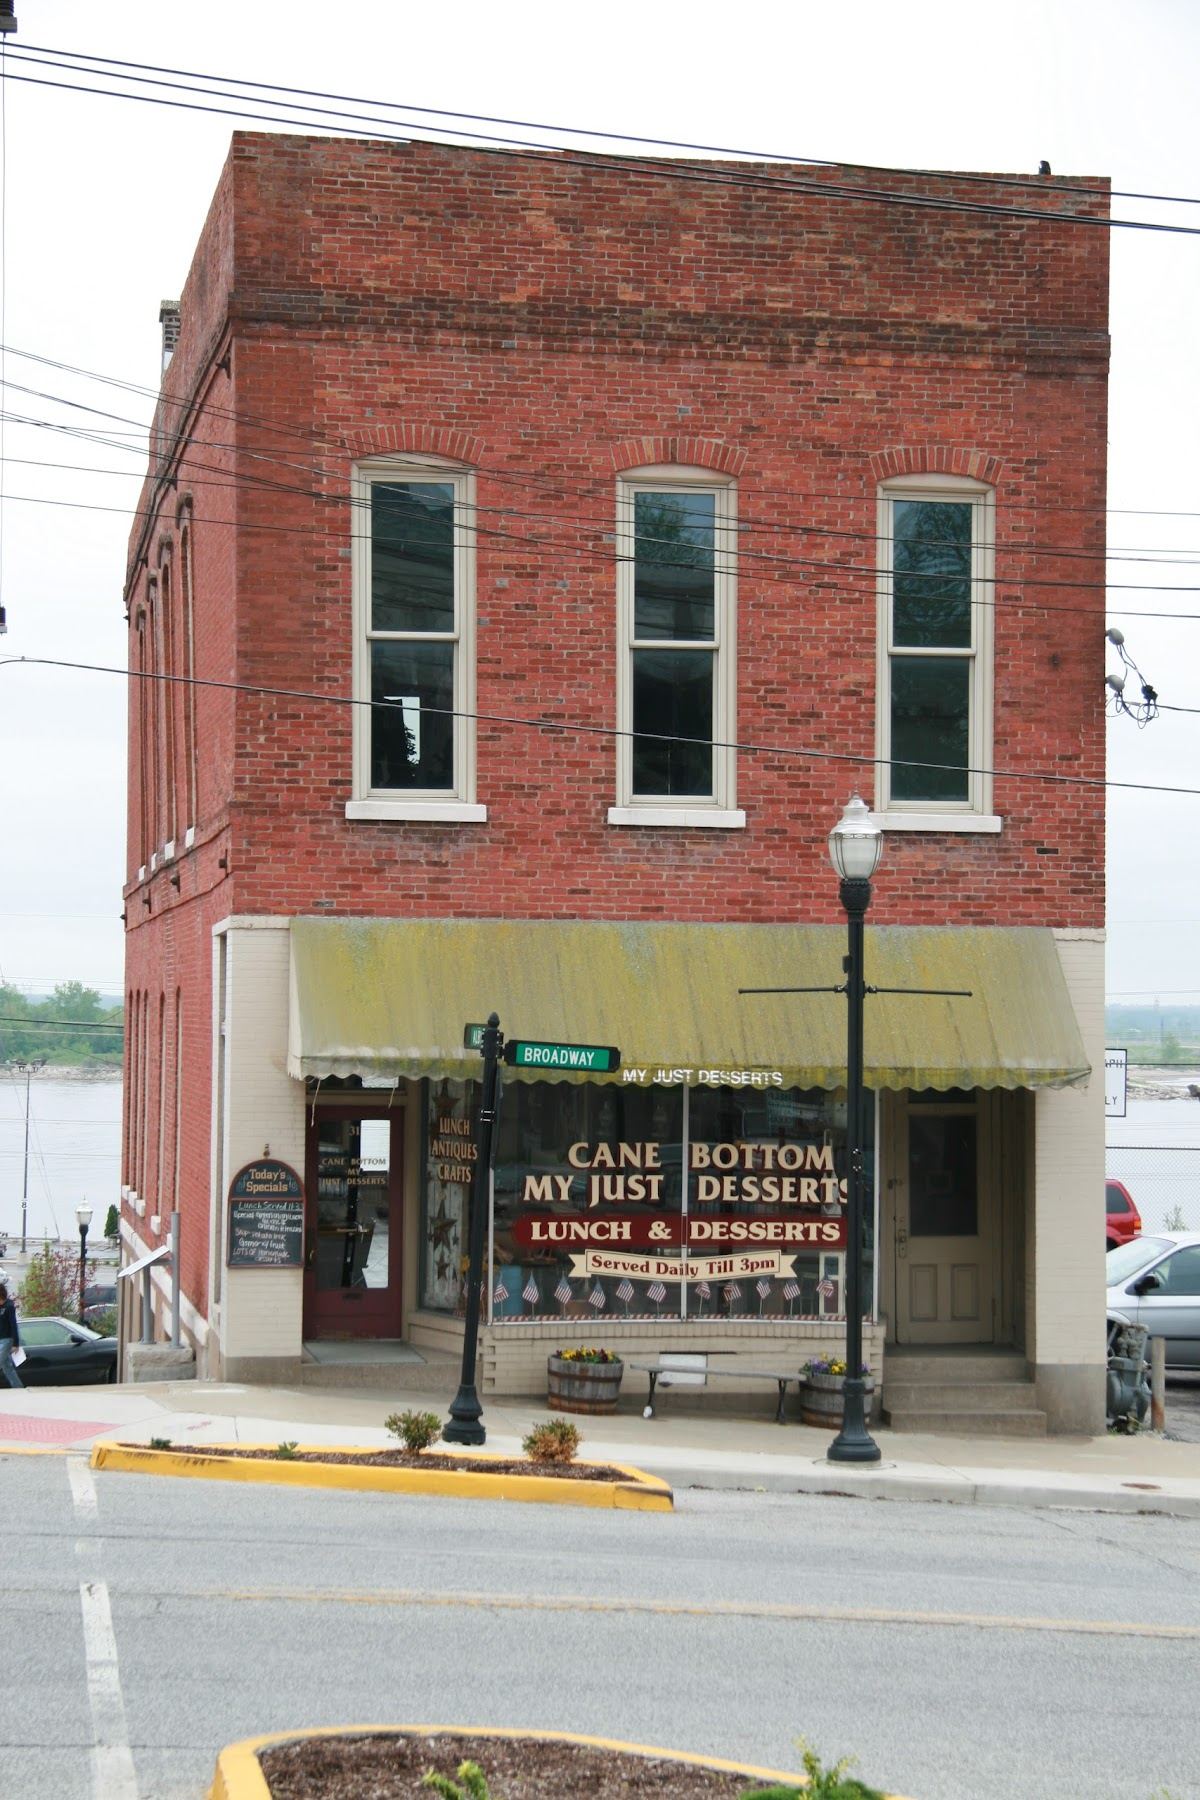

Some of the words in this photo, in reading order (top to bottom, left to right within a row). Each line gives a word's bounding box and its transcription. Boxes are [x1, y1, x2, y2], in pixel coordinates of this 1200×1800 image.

[524, 1047, 595, 1066] BROADWAY
[623, 1069, 647, 1082] MY
[653, 1069, 693, 1083] JUST
[699, 1070, 783, 1086] DESSERTS
[440, 1117, 470, 1136] LUNCH
[431, 1140, 478, 1161] ANTIQUES
[568, 1142, 662, 1168] CANE
[691, 1143, 834, 1171] BOTTOM
[322, 1158, 345, 1166] CANE
[249, 1169, 286, 1181] Today's
[438, 1163, 471, 1183] CRAFTS
[246, 1182, 288, 1193] Specials
[523, 1175, 574, 1200] MY
[590, 1175, 664, 1207] JUST
[531, 1221, 631, 1240] LUNCH
[648, 1221, 672, 1240] &
[690, 1221, 840, 1242] DESSERTS
[591, 1254, 650, 1274] Served
[655, 1261, 699, 1278] Daily
[706, 1259, 734, 1275] Till
[740, 1257, 775, 1273] 3pm
